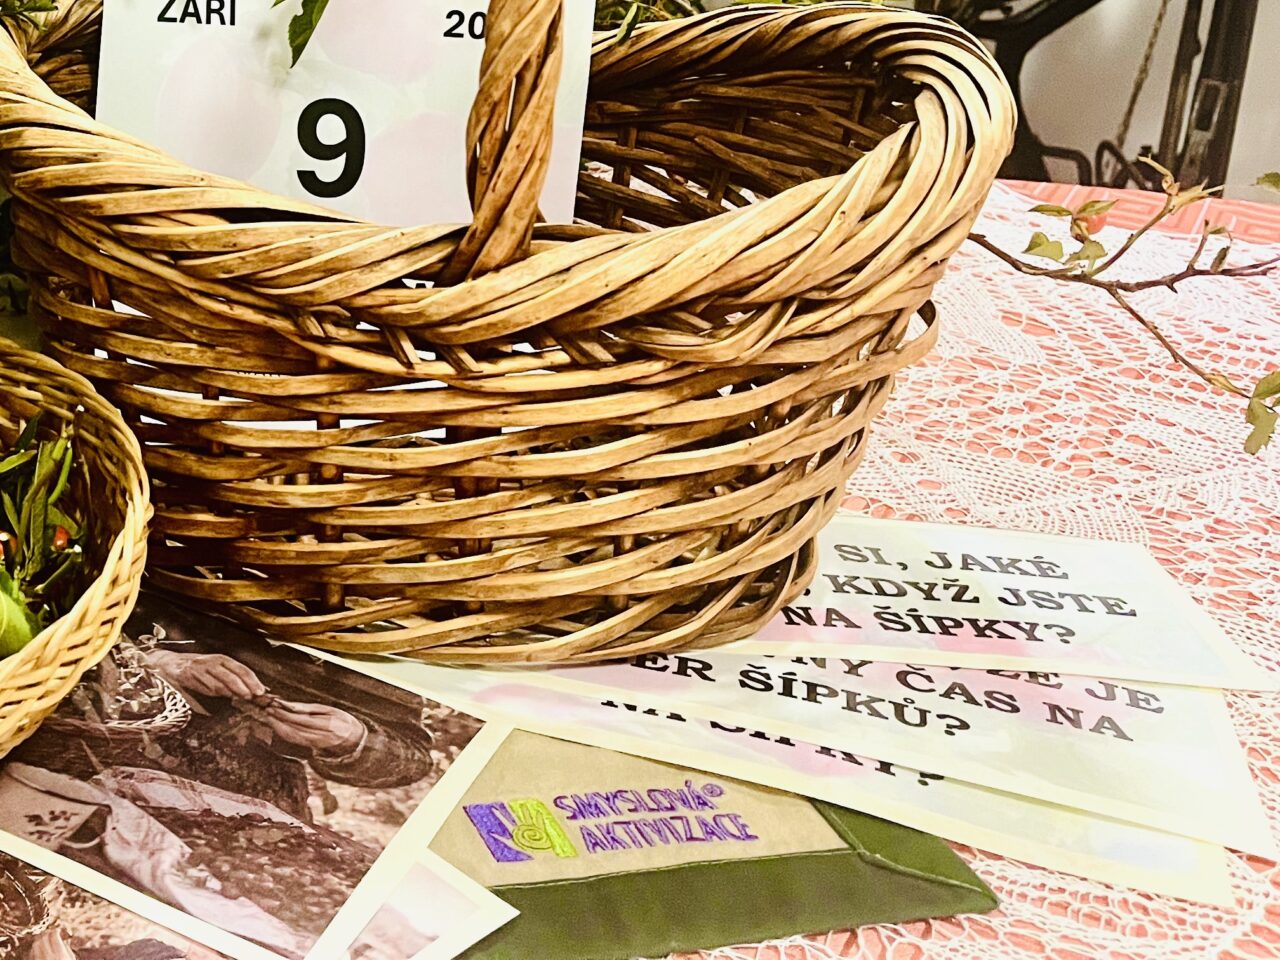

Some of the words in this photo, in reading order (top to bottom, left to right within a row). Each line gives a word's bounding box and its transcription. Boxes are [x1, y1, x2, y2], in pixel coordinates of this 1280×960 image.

[443, 9, 487, 40] 20
[296, 97, 366, 199] 9
[833, 544, 908, 571] SI,
[925, 552, 1069, 580] JAKÉ
[822, 573, 980, 604] KDYŽ
[998, 587, 1137, 617] JSTE
[784, 606, 862, 630] NA
[873, 605, 1076, 644] ŠÍPKY?
[738, 663, 971, 737] ŠÍPKŮ?
[896, 663, 1021, 714] ČAS
[1042, 701, 1134, 742] NA
[1084, 680, 1164, 714] JE
[579, 813, 760, 854] AKTIVIZACE
